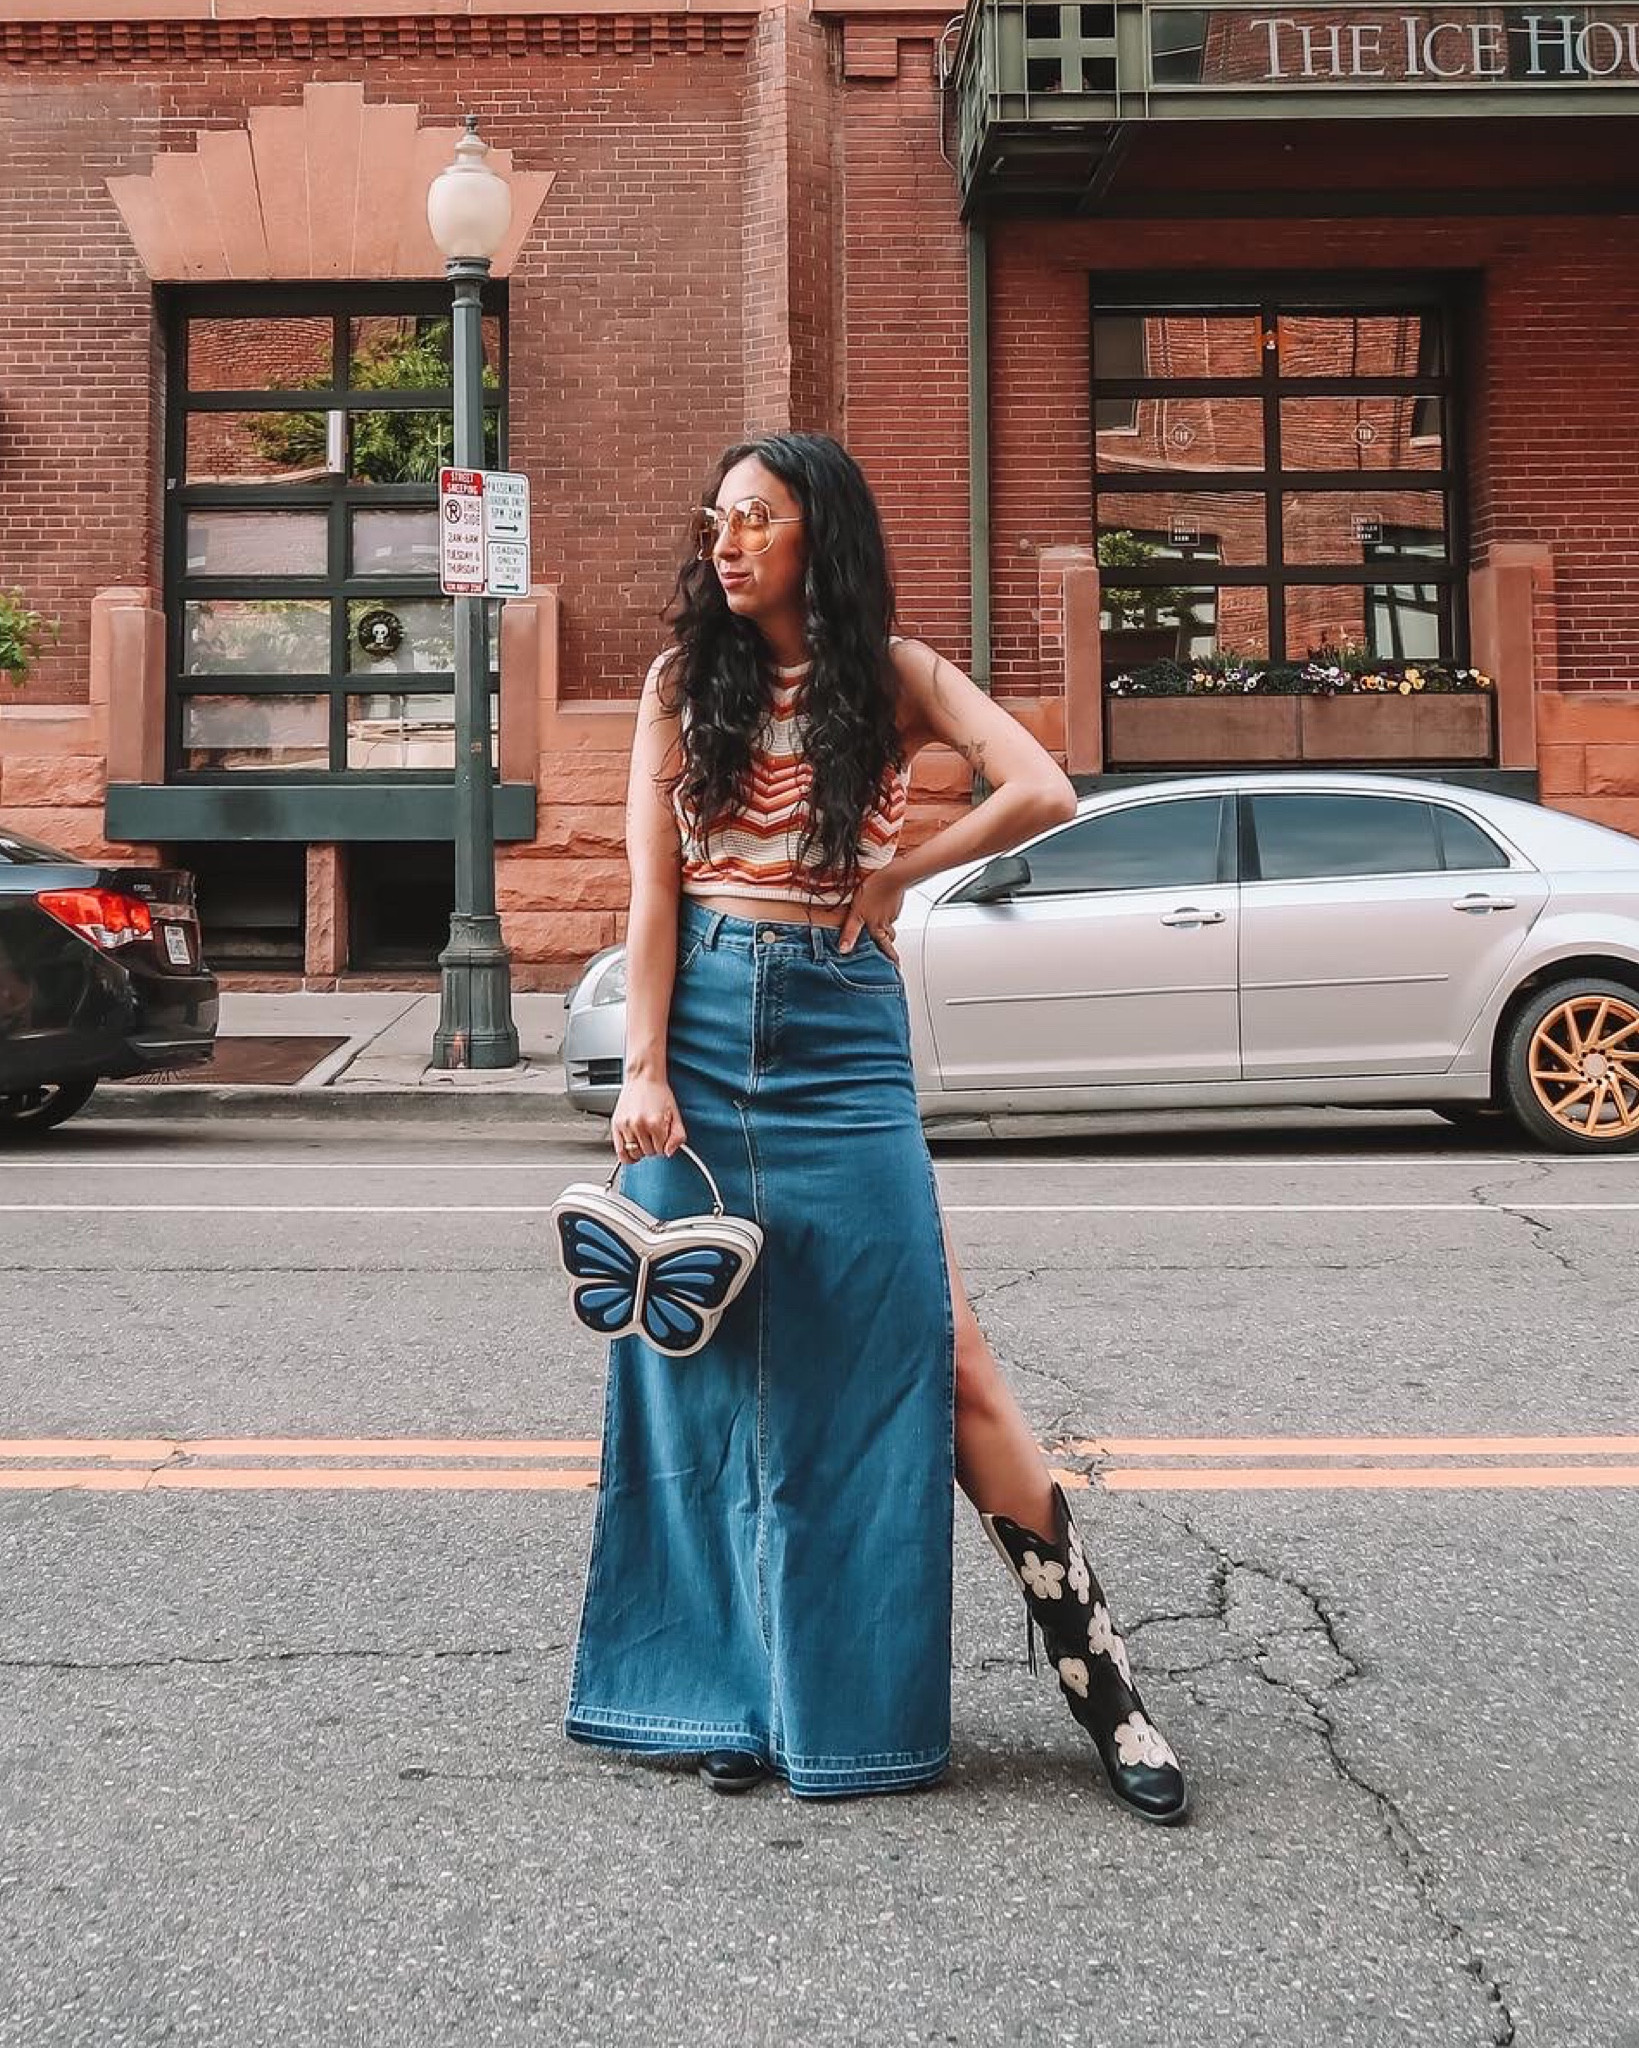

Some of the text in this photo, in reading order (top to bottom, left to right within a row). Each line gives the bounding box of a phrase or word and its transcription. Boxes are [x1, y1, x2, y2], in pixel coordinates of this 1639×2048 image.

[1250, 18, 1385, 78] THE
[1401, 15, 1506, 77] ICE
[451, 471, 474, 482] STREET
[447, 482, 479, 495] SWEEPING
[488, 481, 524, 495] PASSENGER
[464, 500, 480, 512] THIS
[464, 512, 480, 526] SIDE
[446, 549, 473, 561] TUESDAY
[492, 546, 524, 556] LOADING
[498, 556, 517, 565] ONLY
[446, 563, 480, 574] THURSDAY
